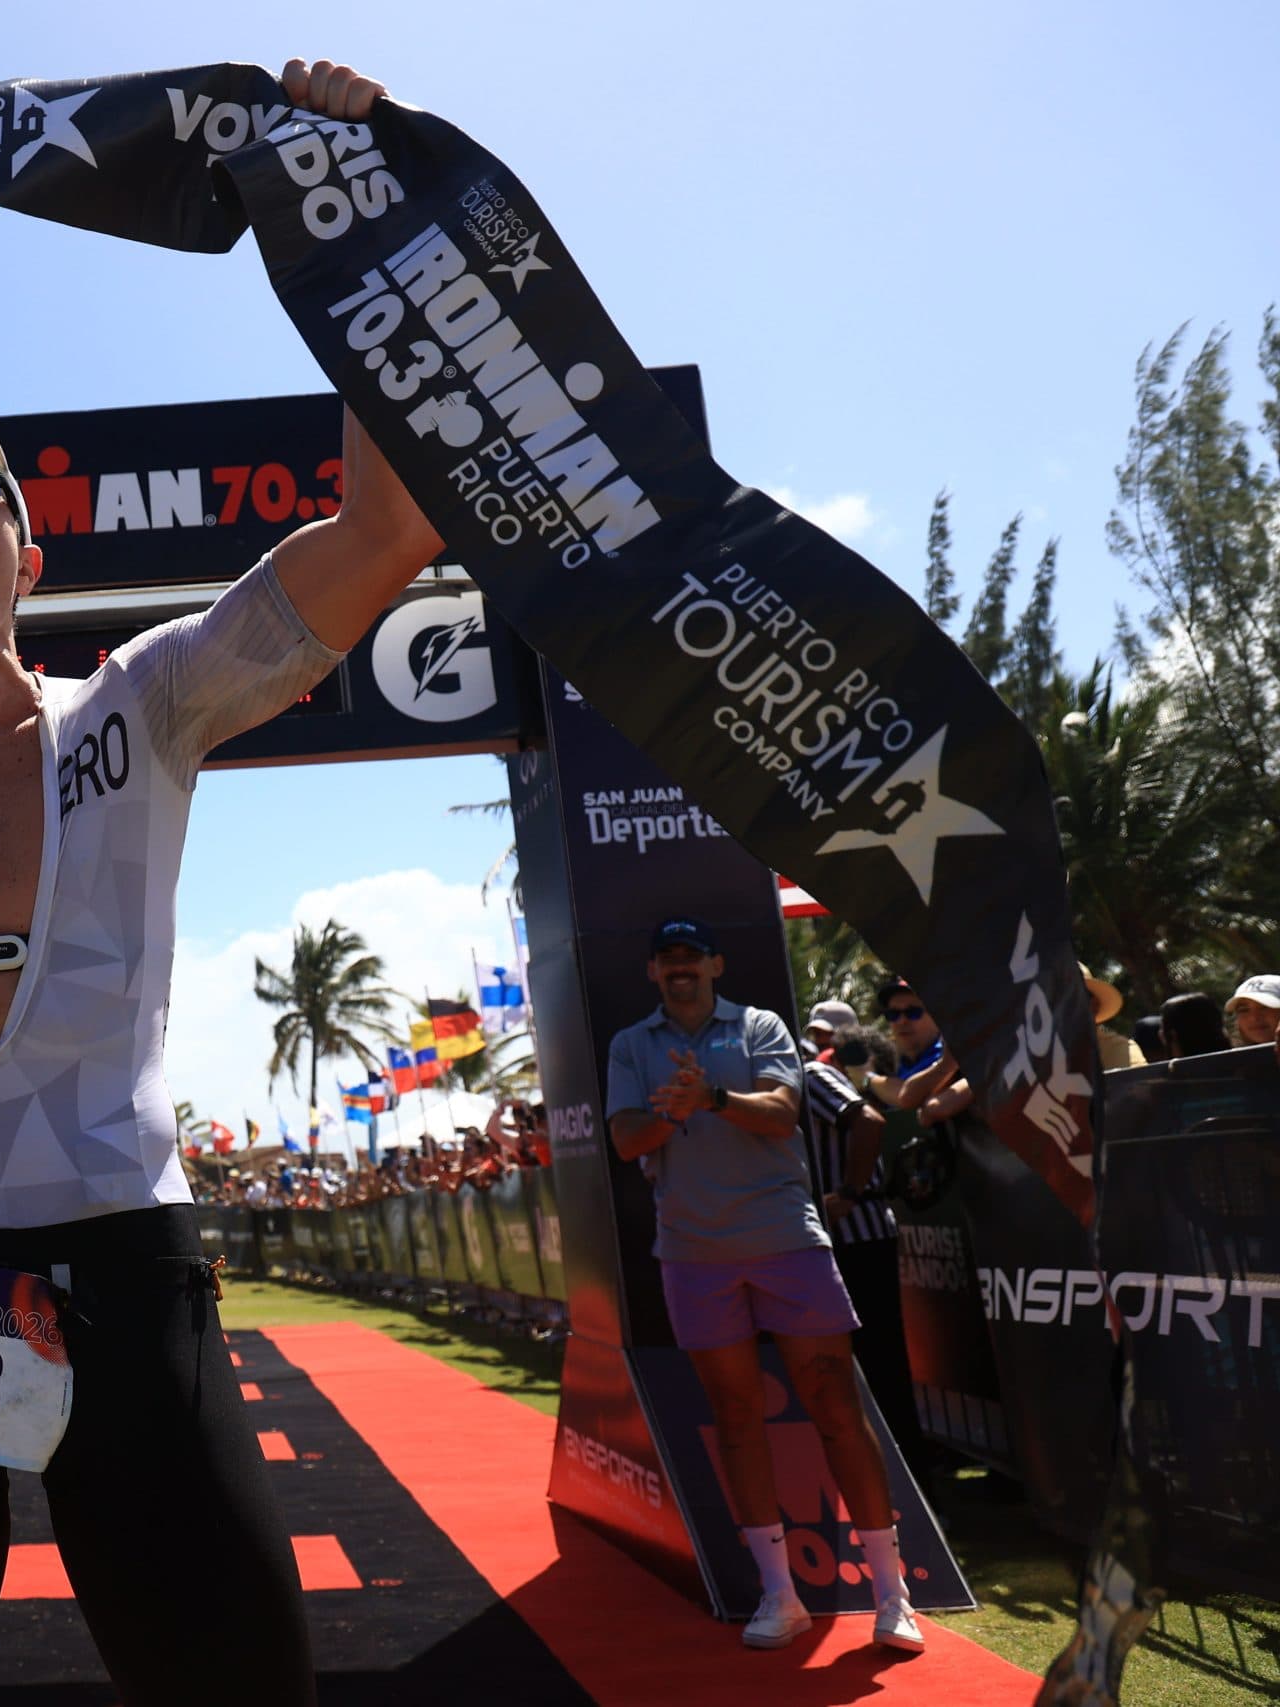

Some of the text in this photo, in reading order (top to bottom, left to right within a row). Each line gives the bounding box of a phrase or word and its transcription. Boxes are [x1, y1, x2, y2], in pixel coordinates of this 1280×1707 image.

[457, 186, 518, 254] TOURISM
[463, 218, 500, 260] COMPANY
[502, 208, 529, 239] RICO
[447, 457, 524, 546] RICO
[479, 436, 591, 570] PUERTO
[651, 573, 883, 803] TOURISM
[712, 563, 914, 752] PUERTO RICO
[582, 785, 684, 807] SAN JUAN
[713, 706, 836, 825] COMPANY
